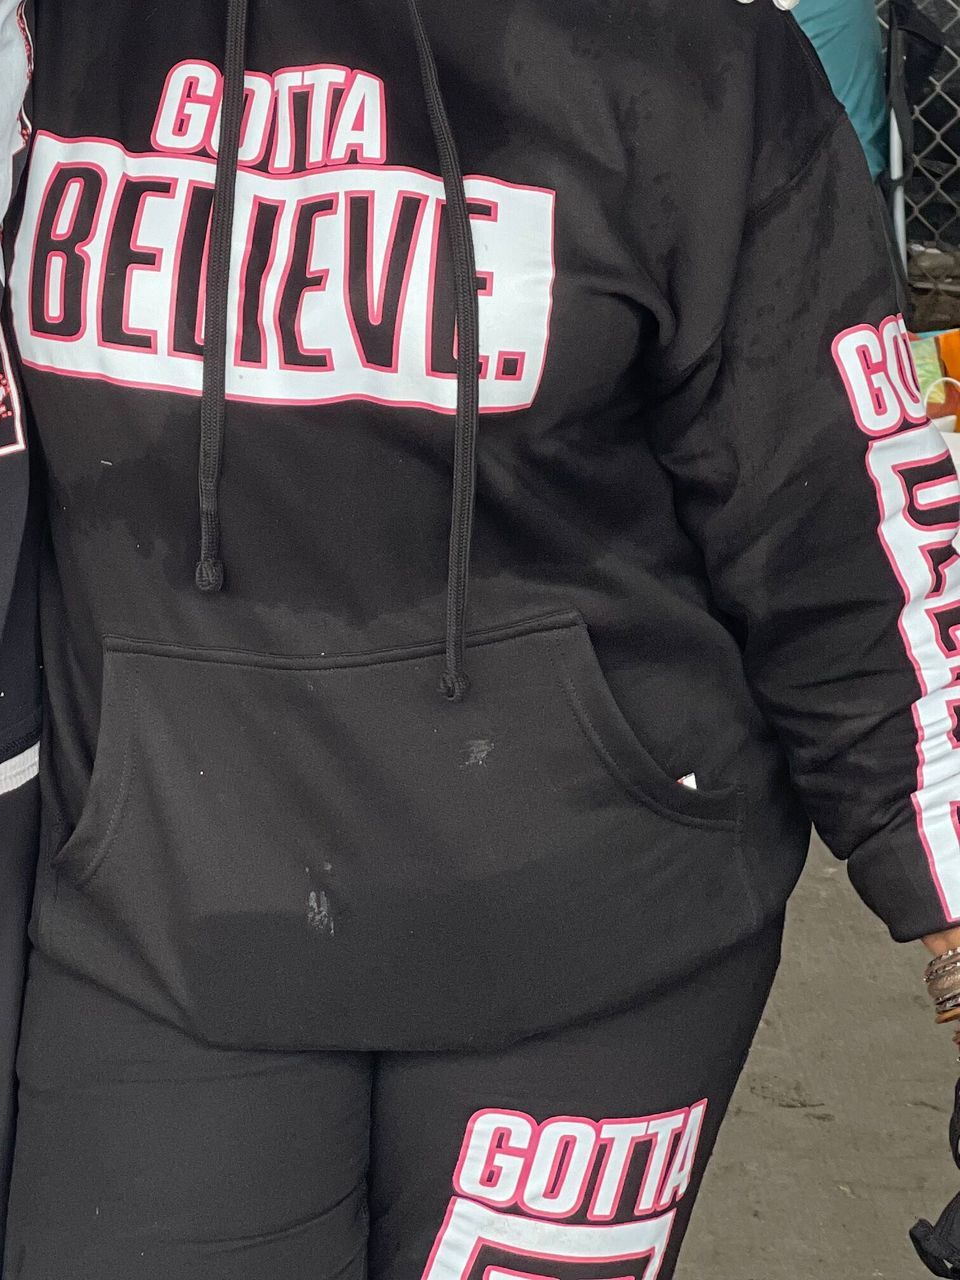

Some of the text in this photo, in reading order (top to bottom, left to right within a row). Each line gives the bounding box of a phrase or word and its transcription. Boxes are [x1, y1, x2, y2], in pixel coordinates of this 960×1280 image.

[151, 58, 386, 173] GOTTA
[28, 161, 525, 382] BELIEVE.
[452, 1097, 709, 1223] GOTTA
